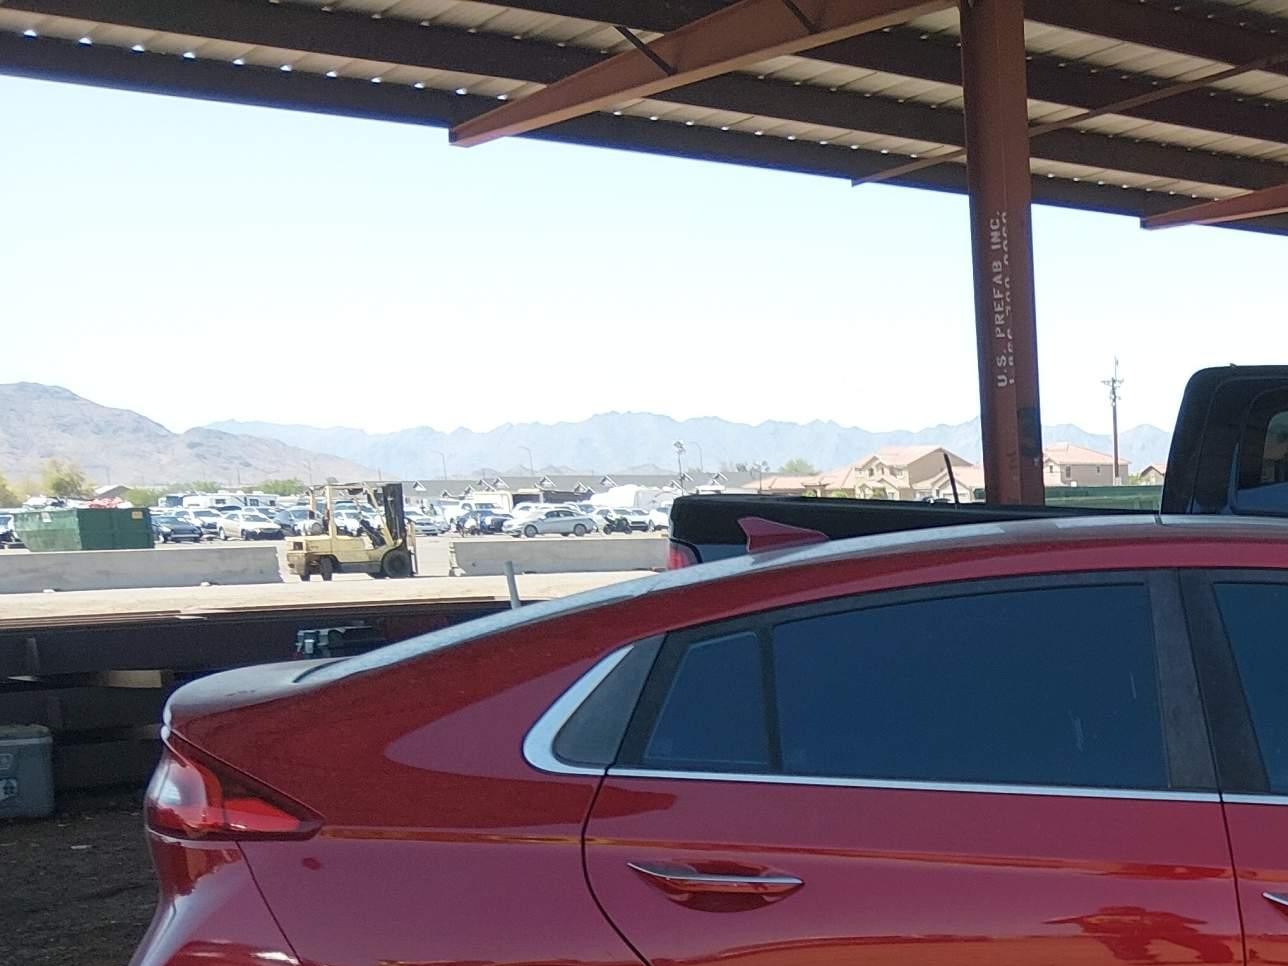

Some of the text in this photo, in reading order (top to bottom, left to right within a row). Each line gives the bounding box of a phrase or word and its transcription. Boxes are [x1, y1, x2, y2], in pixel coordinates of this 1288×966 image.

[990, 210, 1002, 249] INC.
[992, 260, 1005, 338] PREFAB
[997, 350, 1008, 387] U.S.
